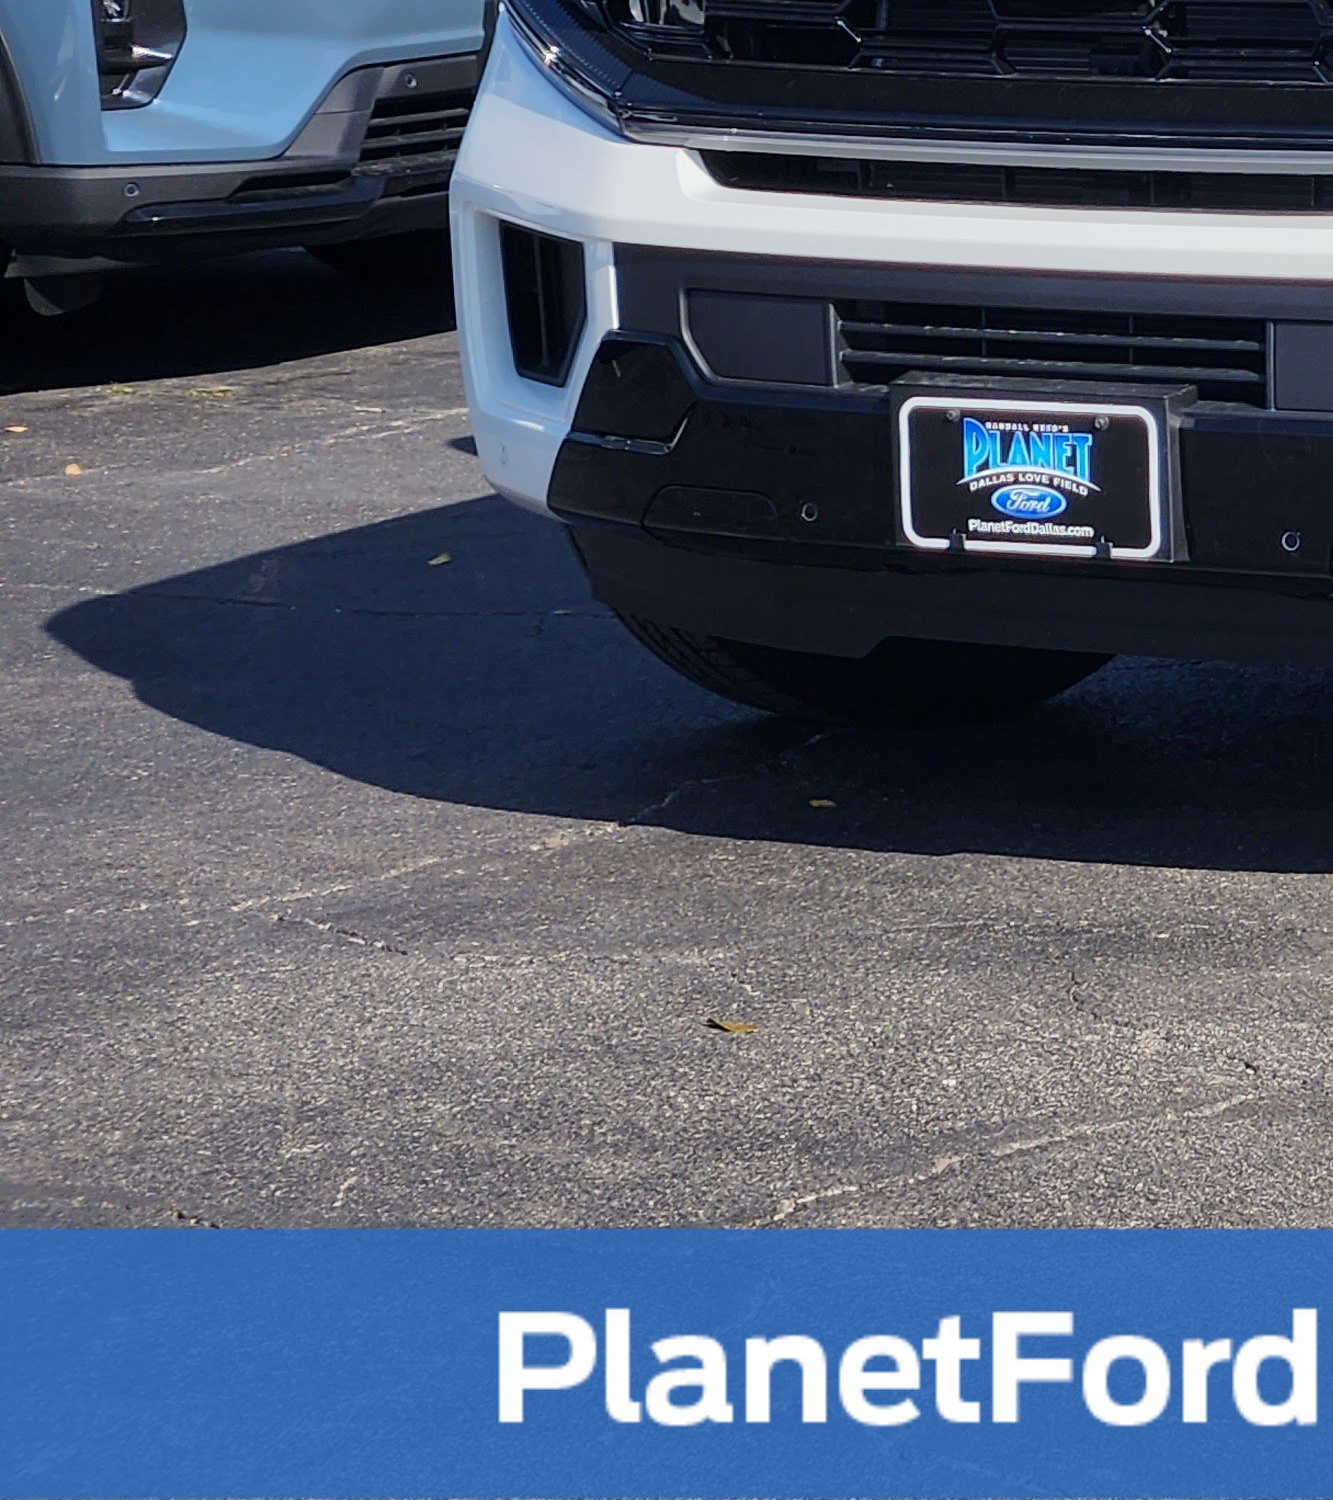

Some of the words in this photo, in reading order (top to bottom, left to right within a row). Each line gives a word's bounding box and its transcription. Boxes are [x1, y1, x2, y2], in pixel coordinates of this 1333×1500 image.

[963, 417, 1093, 481] PLANET
[969, 473, 1014, 492] DALLAS
[1018, 472, 1049, 485] LOVE
[1053, 477, 1088, 497] FIELD
[1005, 490, 1051, 512] Ford
[967, 518, 1094, 538] PlanetFordDallas.com
